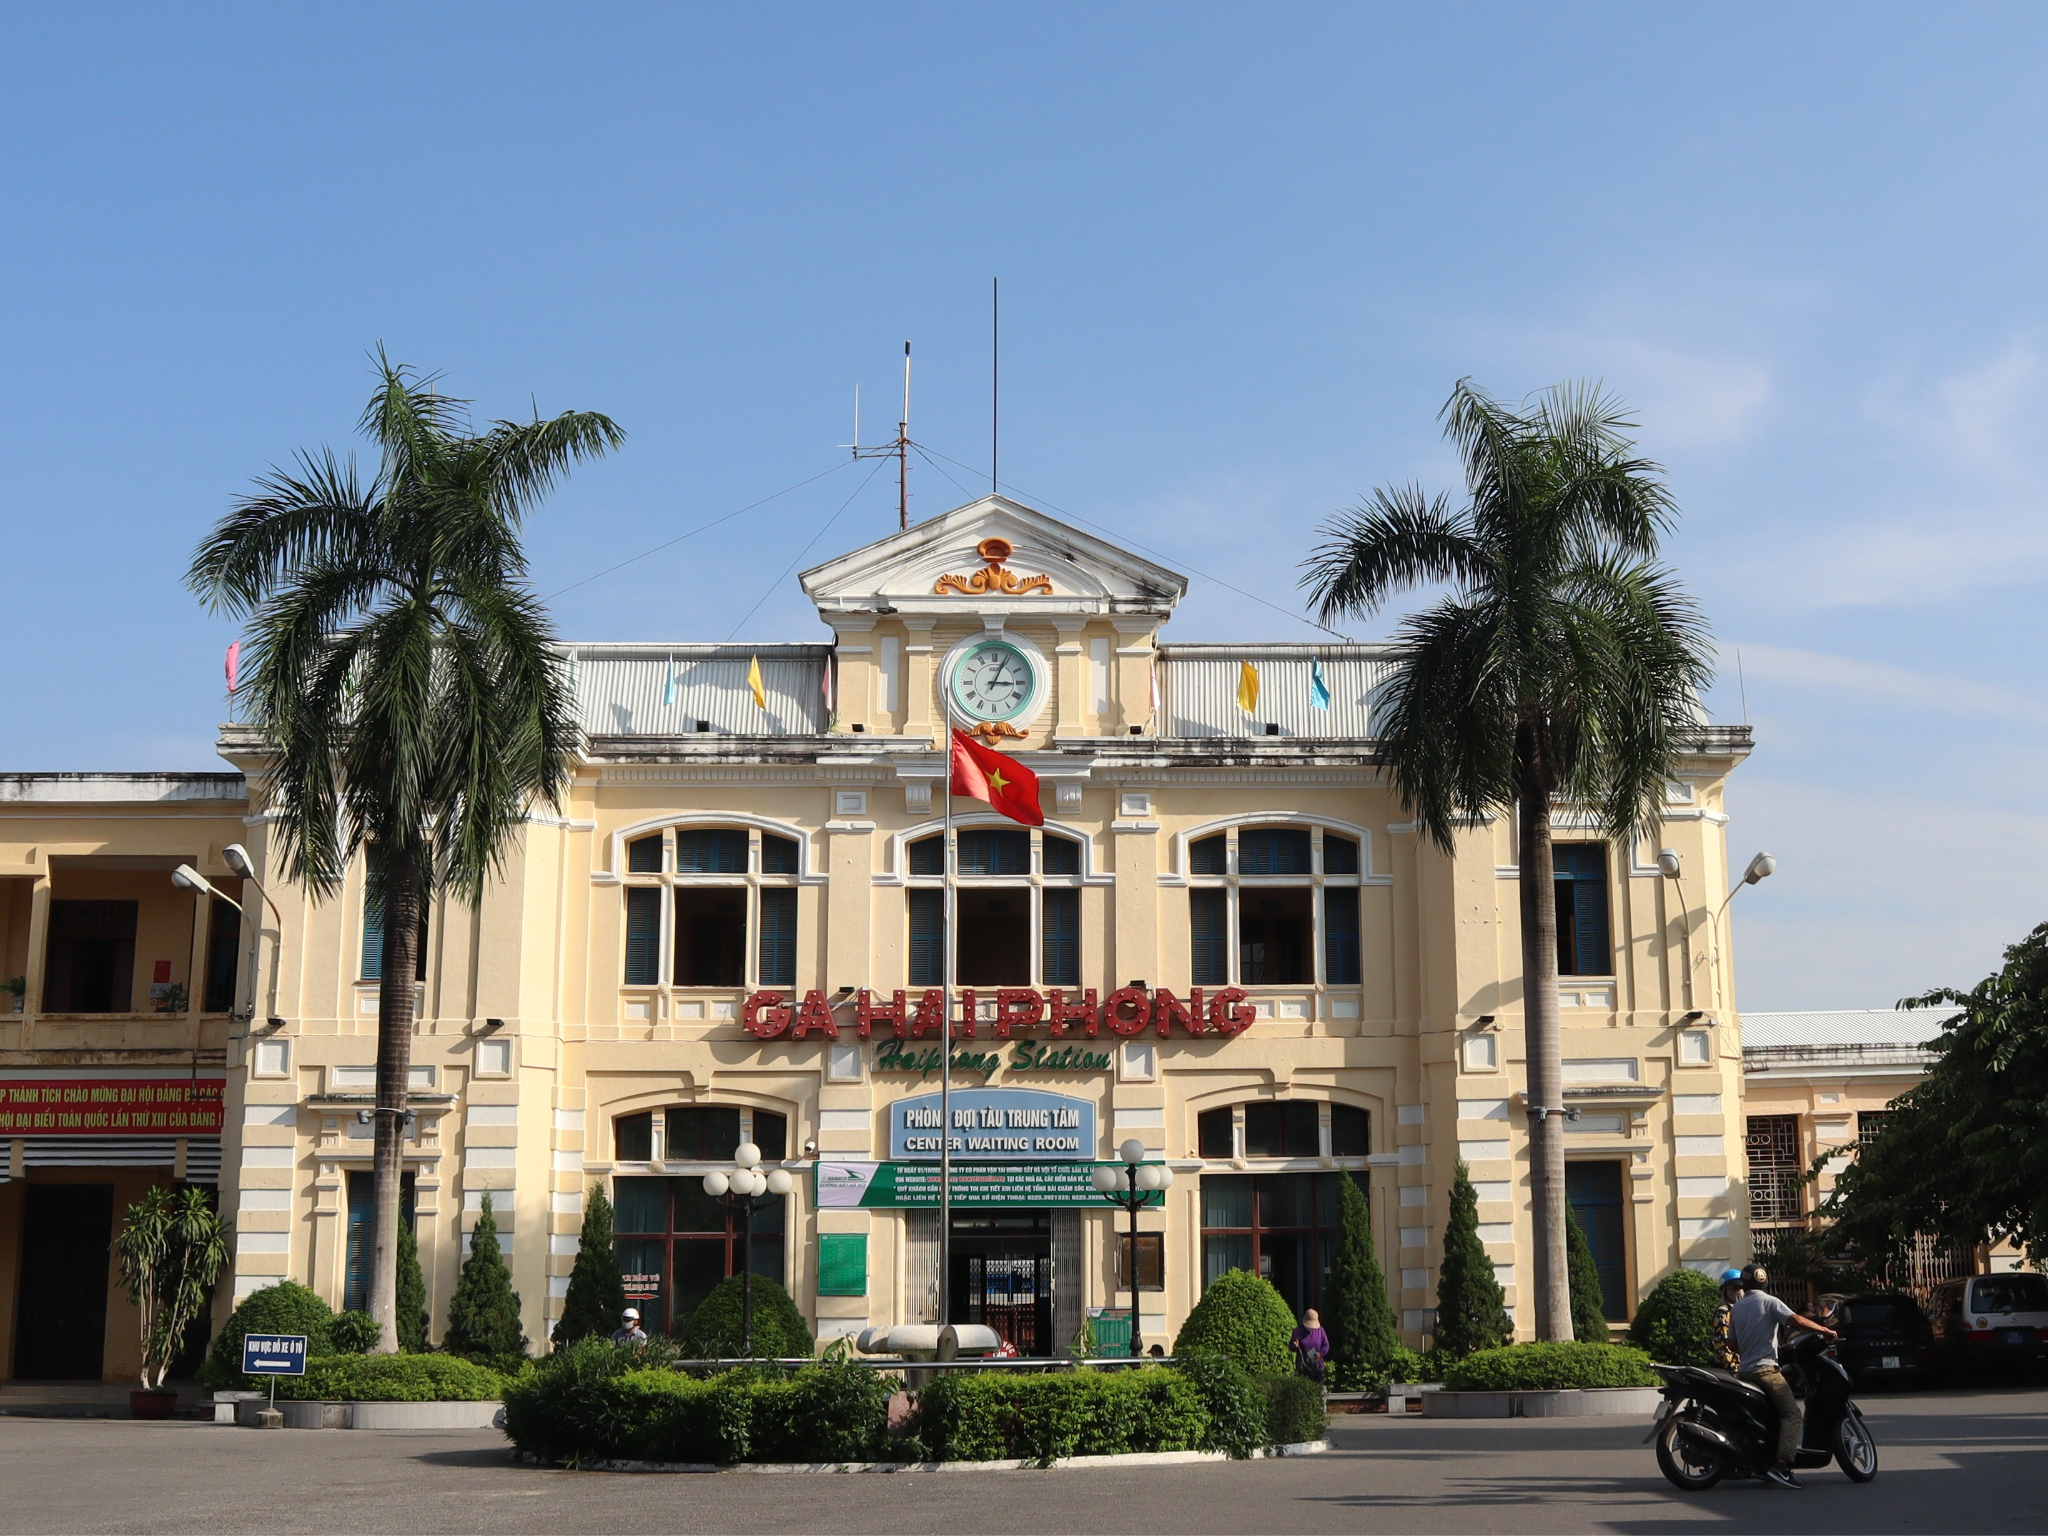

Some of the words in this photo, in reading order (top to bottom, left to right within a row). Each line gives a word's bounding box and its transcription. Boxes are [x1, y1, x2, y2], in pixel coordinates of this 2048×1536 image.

[743, 990, 840, 1038] GA
[857, 989, 976, 1037] HAI
[997, 988, 1256, 1036] PHONG
[1012, 1039, 1111, 1071] Station
[9, 1085, 39, 1103] THÀNH
[41, 1085, 62, 1103] TÍCH
[64, 1085, 89, 1103] CHÀO
[91, 1085, 119, 1103] MỪNG
[121, 1087, 136, 1106] ĐẠI
[138, 1085, 154, 1106] HỘI
[157, 1083, 182, 1103] ĐẢNG
[16, 1113, 32, 1131] ĐẠI
[34, 1107, 56, 1127] BIỂU
[58, 1109, 82, 1127] TOÀN
[84, 1107, 109, 1129] QUỐC
[132, 1109, 150, 1127] THỨ
[151, 1113, 167, 1127] XIII
[169, 1108, 188, 1127] CỦA
[190, 1107, 216, 1127] ĐẢNG
[954, 1108, 976, 1132] ĐỢI
[980, 1105, 1004, 1128] TÀU
[1008, 1109, 1049, 1128] TRUNG
[1052, 1105, 1080, 1128] TÂM
[906, 1137, 962, 1150] CENTER
[968, 1137, 1029, 1150] WAITING
[1035, 1137, 1080, 1150] ROOM
[281, 1341, 289, 1353] XE
